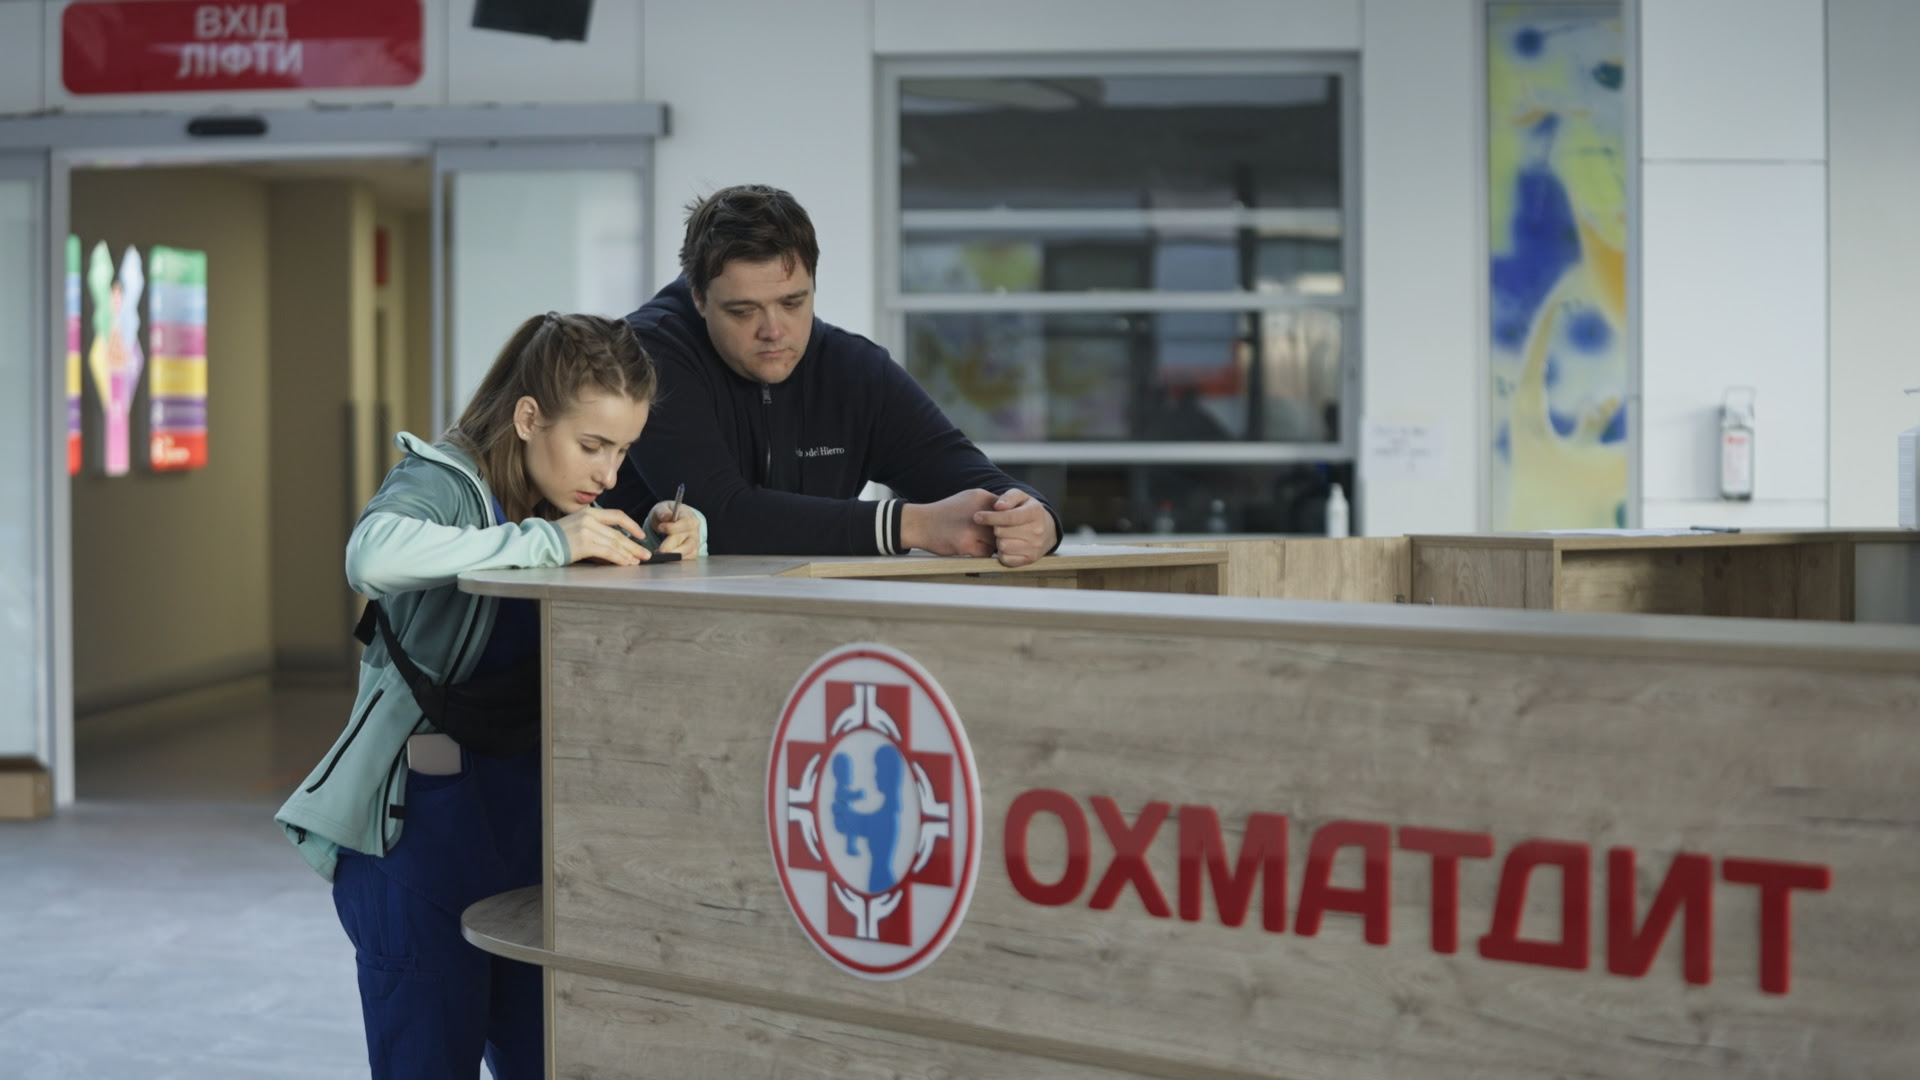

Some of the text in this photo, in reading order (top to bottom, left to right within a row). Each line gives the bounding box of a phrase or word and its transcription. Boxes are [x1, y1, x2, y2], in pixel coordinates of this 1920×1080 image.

[195, 3, 288, 40] ВХІД
[177, 41, 303, 78] ЛІФТИ
[820, 446, 845, 456] Hierro
[1003, 789, 1831, 995] ОХМАТДИТ
